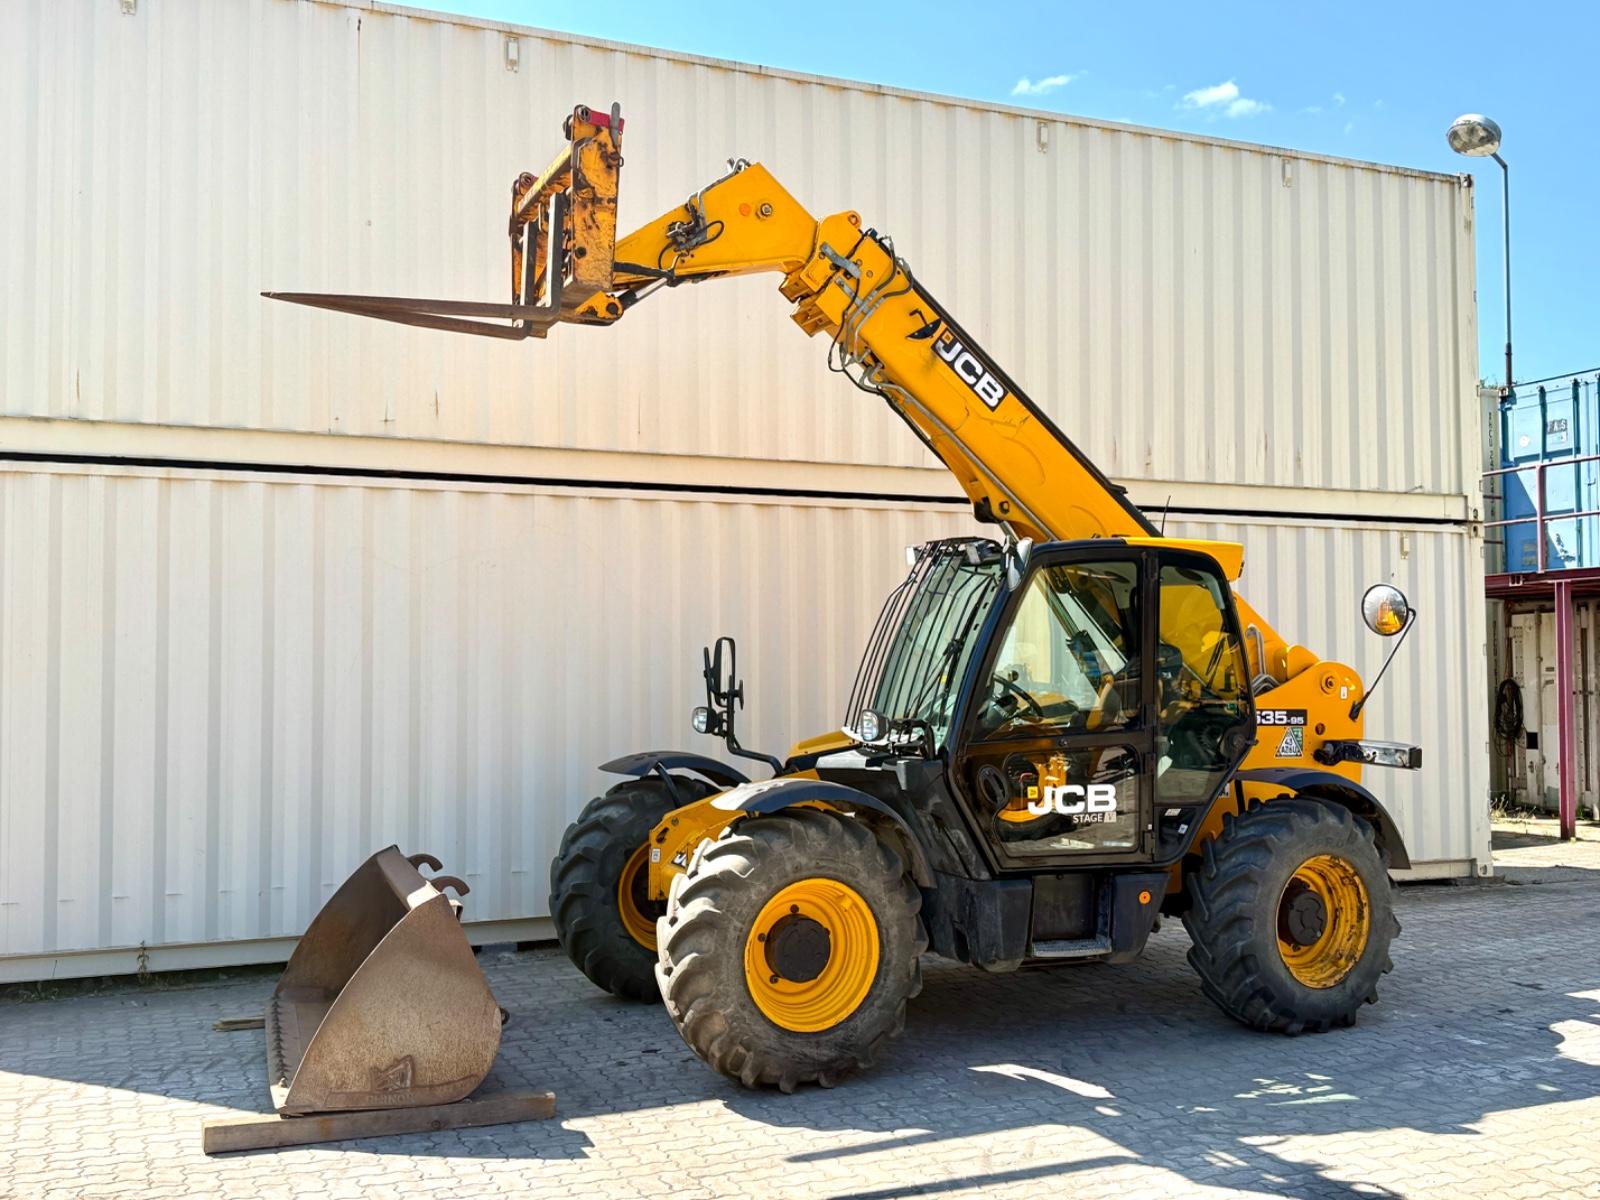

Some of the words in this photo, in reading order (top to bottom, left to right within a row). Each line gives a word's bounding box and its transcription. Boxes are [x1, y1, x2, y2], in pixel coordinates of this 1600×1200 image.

[935, 332, 1005, 407] JCB
[1027, 784, 1117, 815] JCB
[1072, 813, 1104, 824] STAGE
